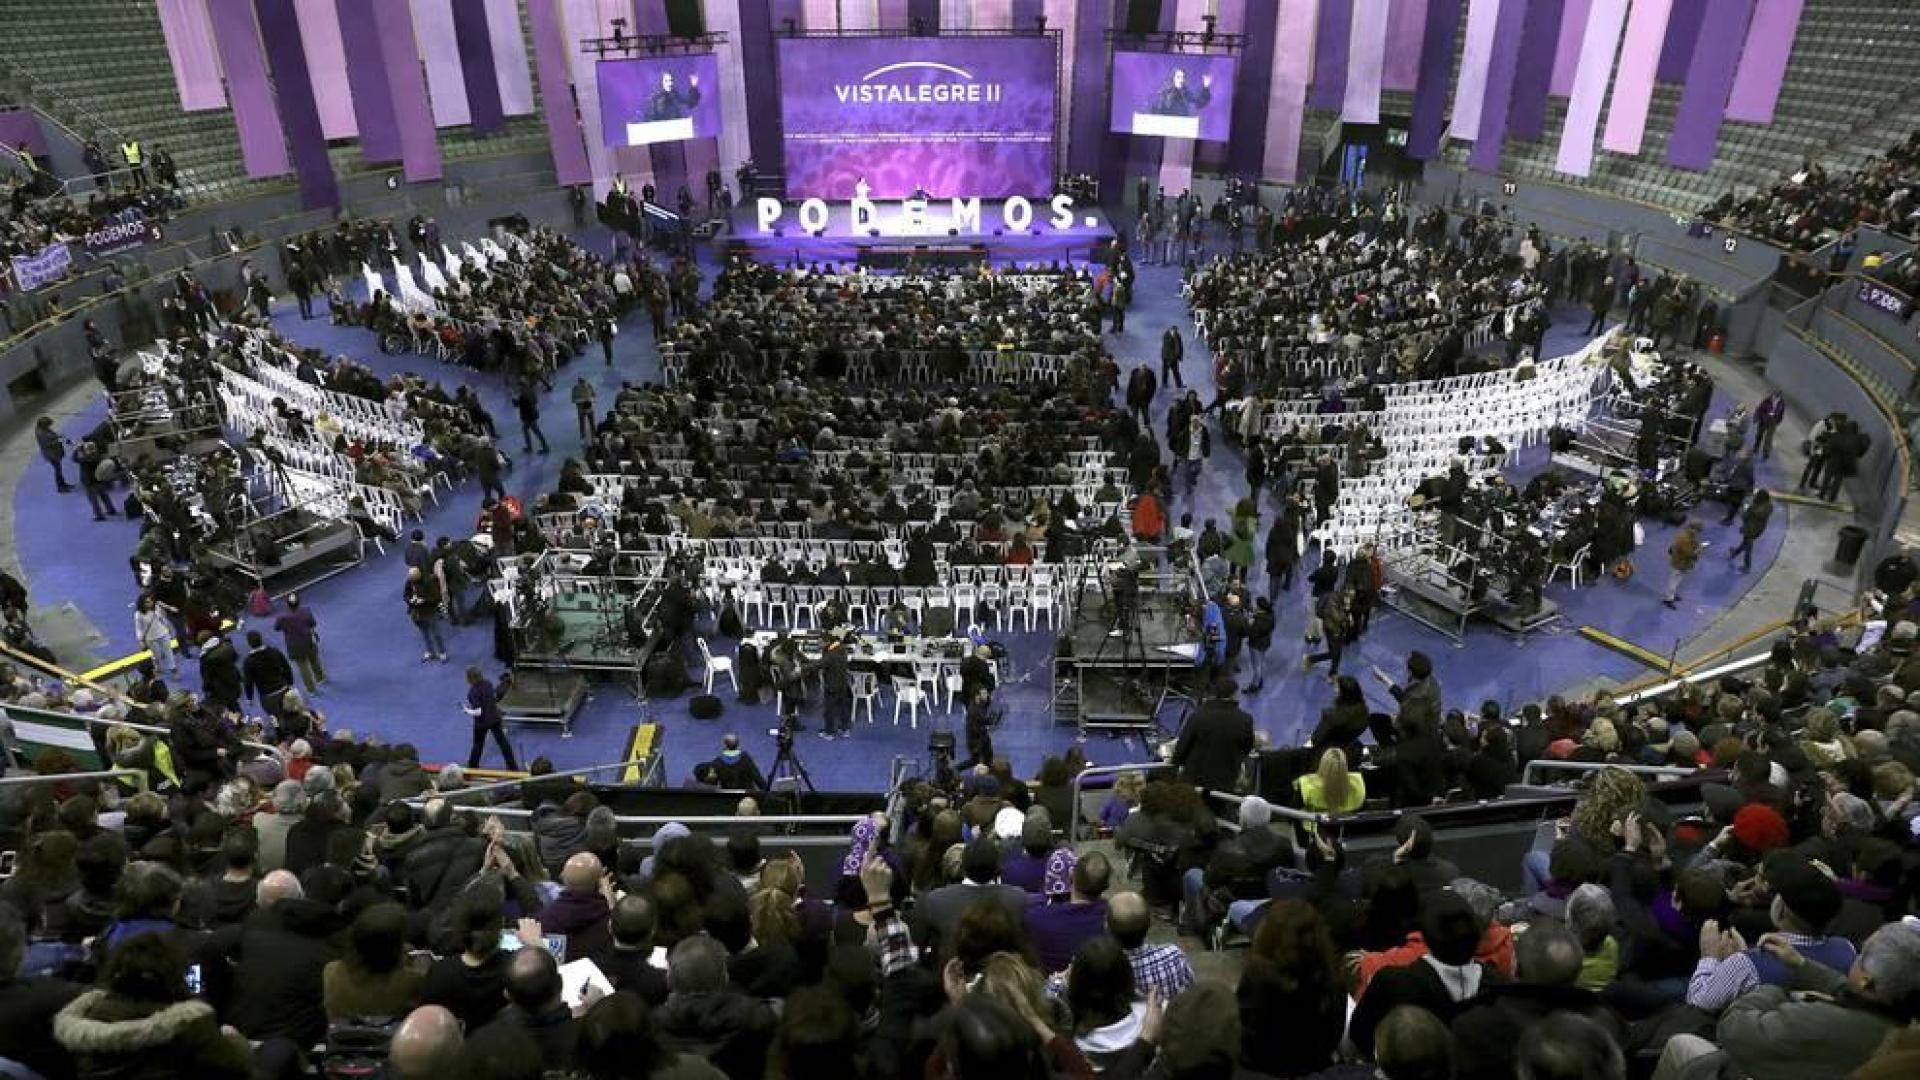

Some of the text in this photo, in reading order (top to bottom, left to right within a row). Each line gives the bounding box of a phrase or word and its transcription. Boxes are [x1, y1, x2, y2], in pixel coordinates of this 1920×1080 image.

[835, 84, 1000, 102] VISTALEGRE II
[84, 220, 145, 248] PODEMOS
